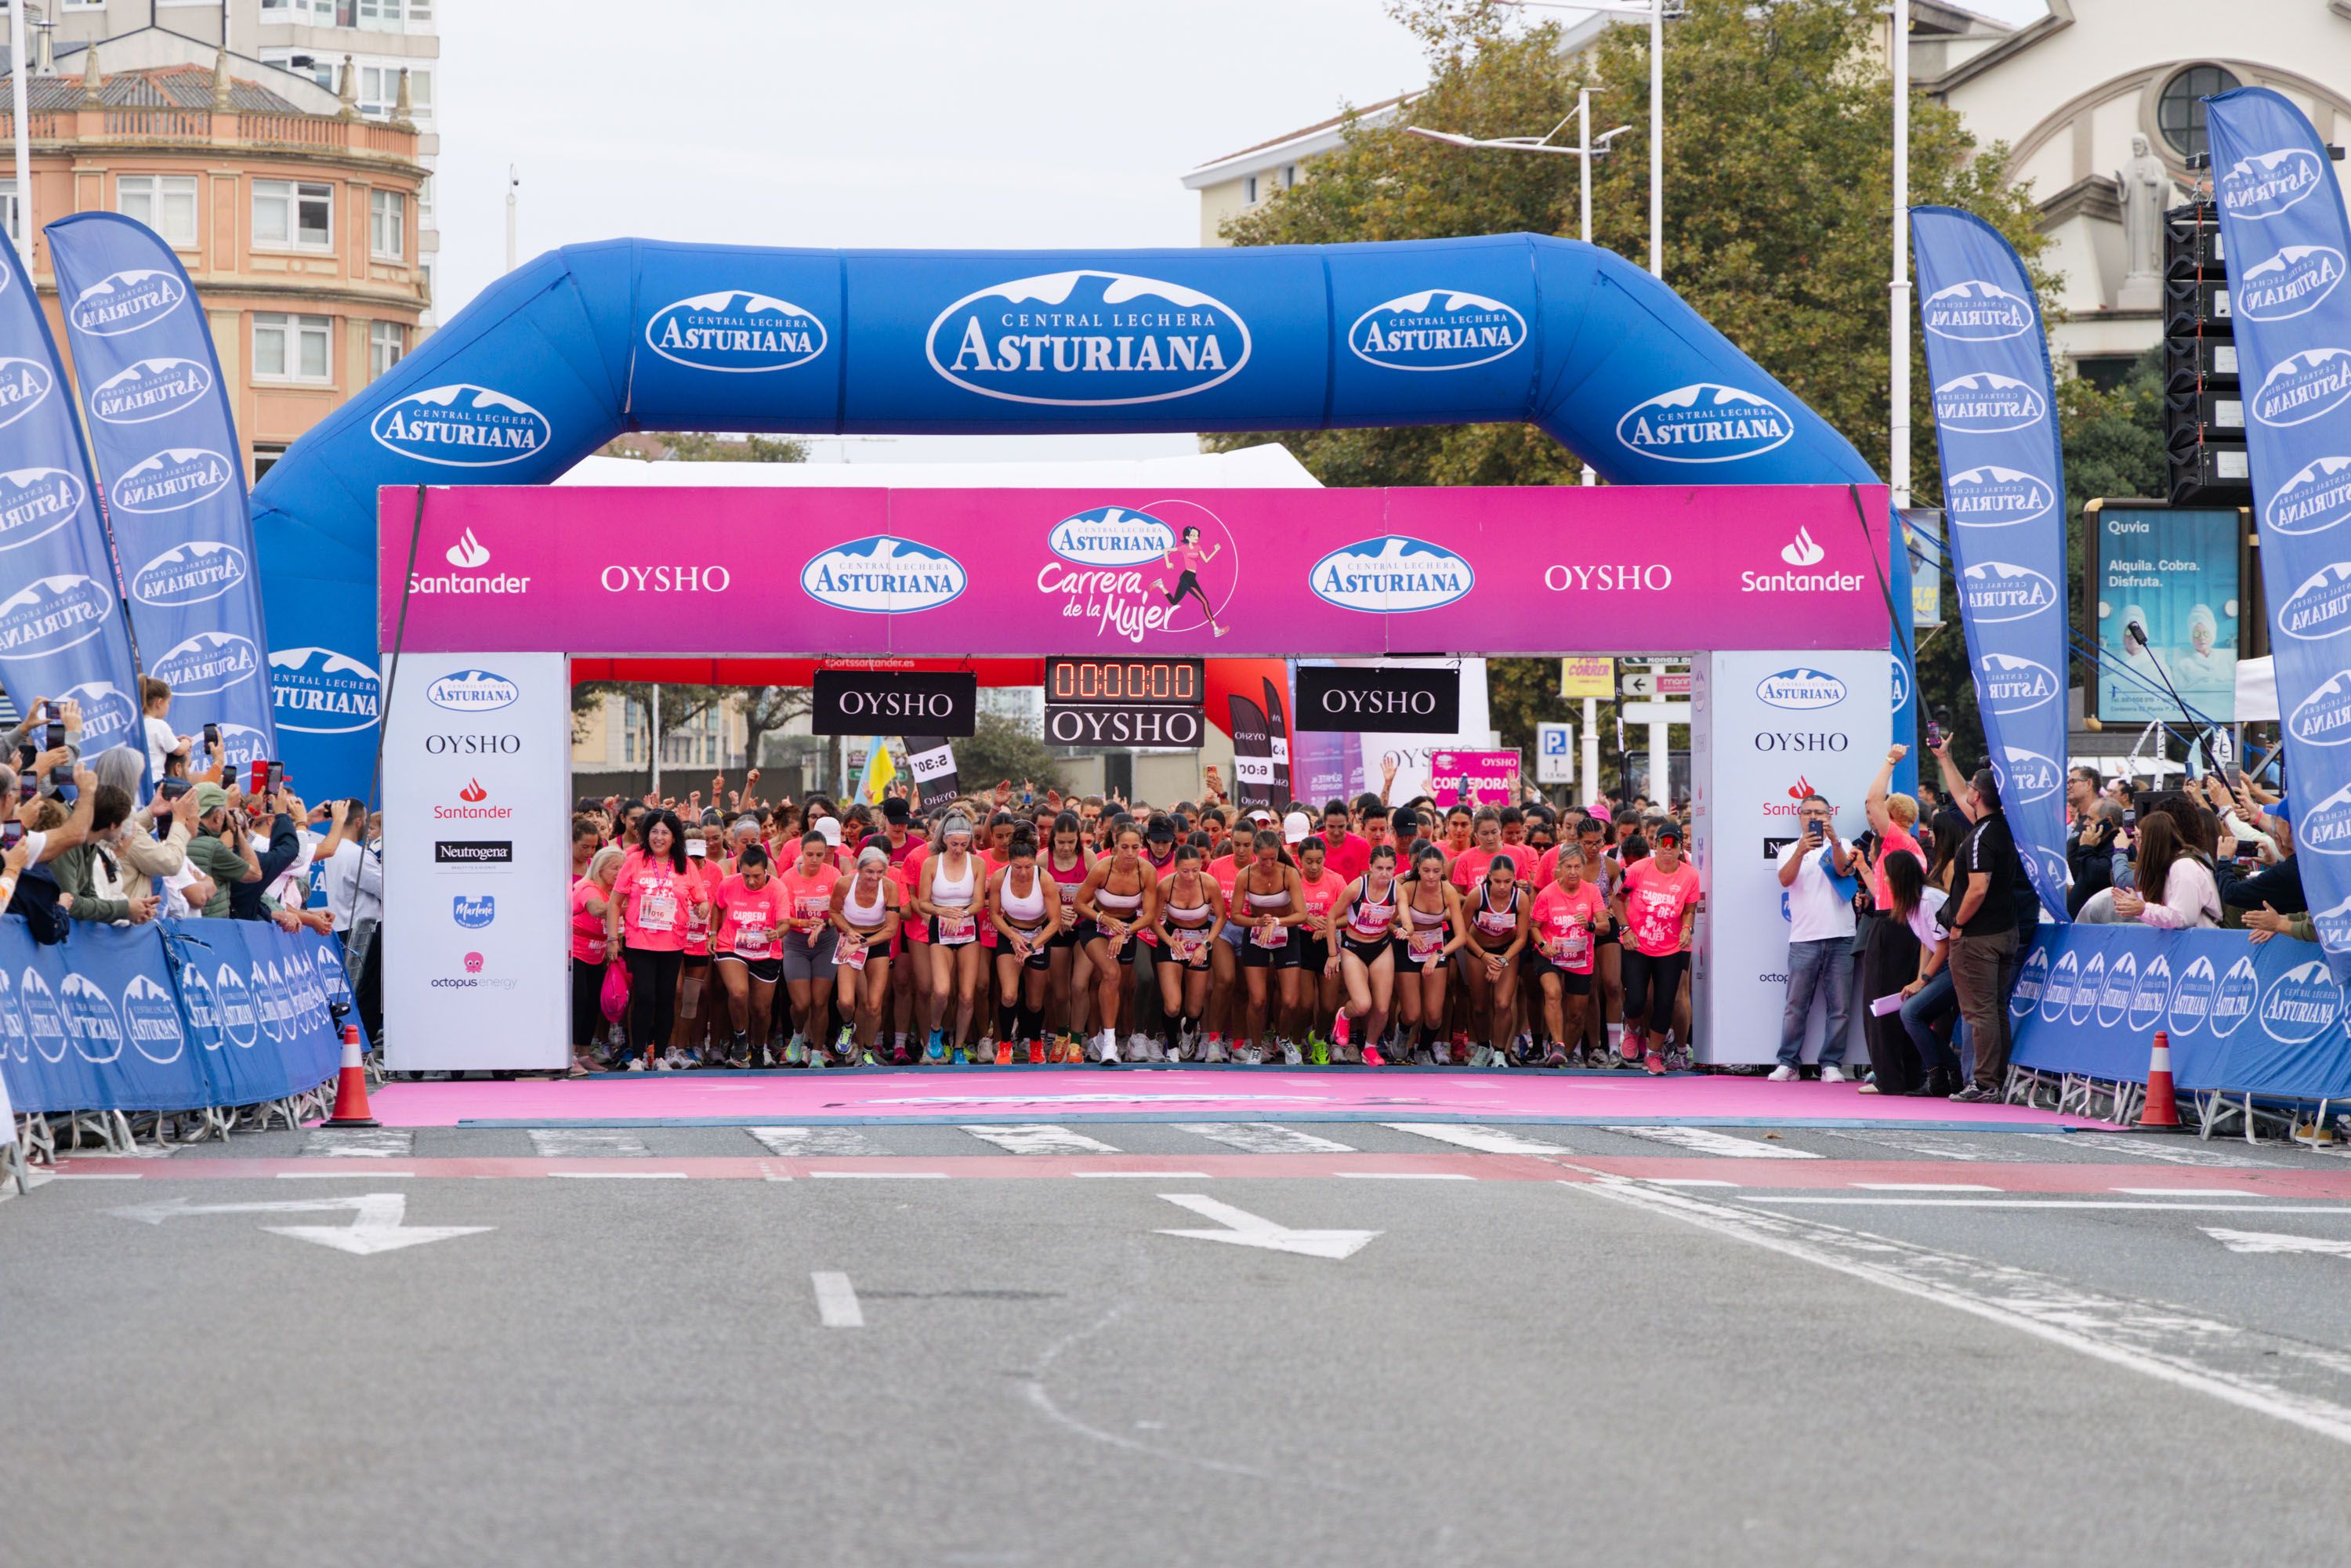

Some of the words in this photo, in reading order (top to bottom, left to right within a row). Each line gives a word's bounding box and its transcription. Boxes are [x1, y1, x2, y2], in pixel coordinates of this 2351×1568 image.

[688, 316, 745, 327] CENTRAL
[750, 317, 808, 328] LECHERA
[1002, 313, 1105, 328] CENTRAL
[1113, 313, 1215, 328] LECHERA
[1389, 316, 1446, 328] CENTRAL
[1451, 313, 1508, 324] LECHERA
[659, 316, 813, 353] ASTURIANA
[951, 315, 1227, 371] ASTURIANA
[1362, 321, 1513, 353] ASTURIANA
[414, 409, 470, 422] CENTRAL
[476, 414, 534, 426] LECHERA
[1657, 411, 1716, 422] CENTRAL
[1720, 408, 1773, 419] LECHERA
[382, 410, 536, 449] ASTURIANA
[1632, 415, 1785, 445] ASTURIANA
[2108, 520, 2150, 534] Quvia
[1058, 527, 1166, 552] ASTURIANA
[839, 562, 889, 570] CENTRAL
[897, 562, 949, 570] LECHERA
[1348, 562, 1400, 570] CENTRAL
[1404, 561, 1456, 570] LECHERA
[2109, 559, 2156, 574] Alquila.
[2158, 560, 2201, 571] Cobra.
[408, 572, 530, 594] Santander
[601, 565, 730, 592] OYSHO
[814, 563, 955, 593] ASTURIANA
[1037, 562, 1142, 594] Carrera
[1324, 564, 1462, 592] ASTURIANA
[1545, 564, 1672, 591] OYSHO
[1741, 570, 1864, 592] Santander
[2109, 576, 2163, 588] Disfruta.
[1063, 596, 1082, 617] de
[1085, 596, 1101, 617] la
[1098, 590, 1181, 643] Mujer
[1568, 664, 1610, 677] CORRER
[274, 673, 320, 686] ENTRAL
[326, 678, 376, 692] LECHERA
[1763, 683, 1841, 699] ASTURIANA
[272, 686, 378, 716] TURIANA
[434, 685, 512, 701] ASTURIANA
[1322, 689, 1436, 714] OYSHO
[839, 691, 953, 717] OYSHO
[1052, 710, 1197, 743] OYSHO
[426, 734, 520, 755] OYSHO
[1547, 733, 1562, 753] P
[1755, 732, 1849, 751] OYSHO
[1481, 758, 1517, 767] OYSHO
[434, 806, 513, 819] Santander
[1762, 802, 1840, 816] Santer
[440, 845, 508, 860] Neutrogena
[1643, 890, 1675, 905] CARRERA
[455, 902, 494, 921] Marlene
[734, 911, 766, 922] CARRERA
[1657, 906, 1671, 919] DE
[1639, 928, 1665, 942] MUJER
[431, 977, 477, 990] octopus
[479, 978, 518, 990] energy
[1759, 972, 1789, 985] octop
[2312, 990, 2339, 1000] LECHERA
[2264, 988, 2335, 1024] ASTURIANA
